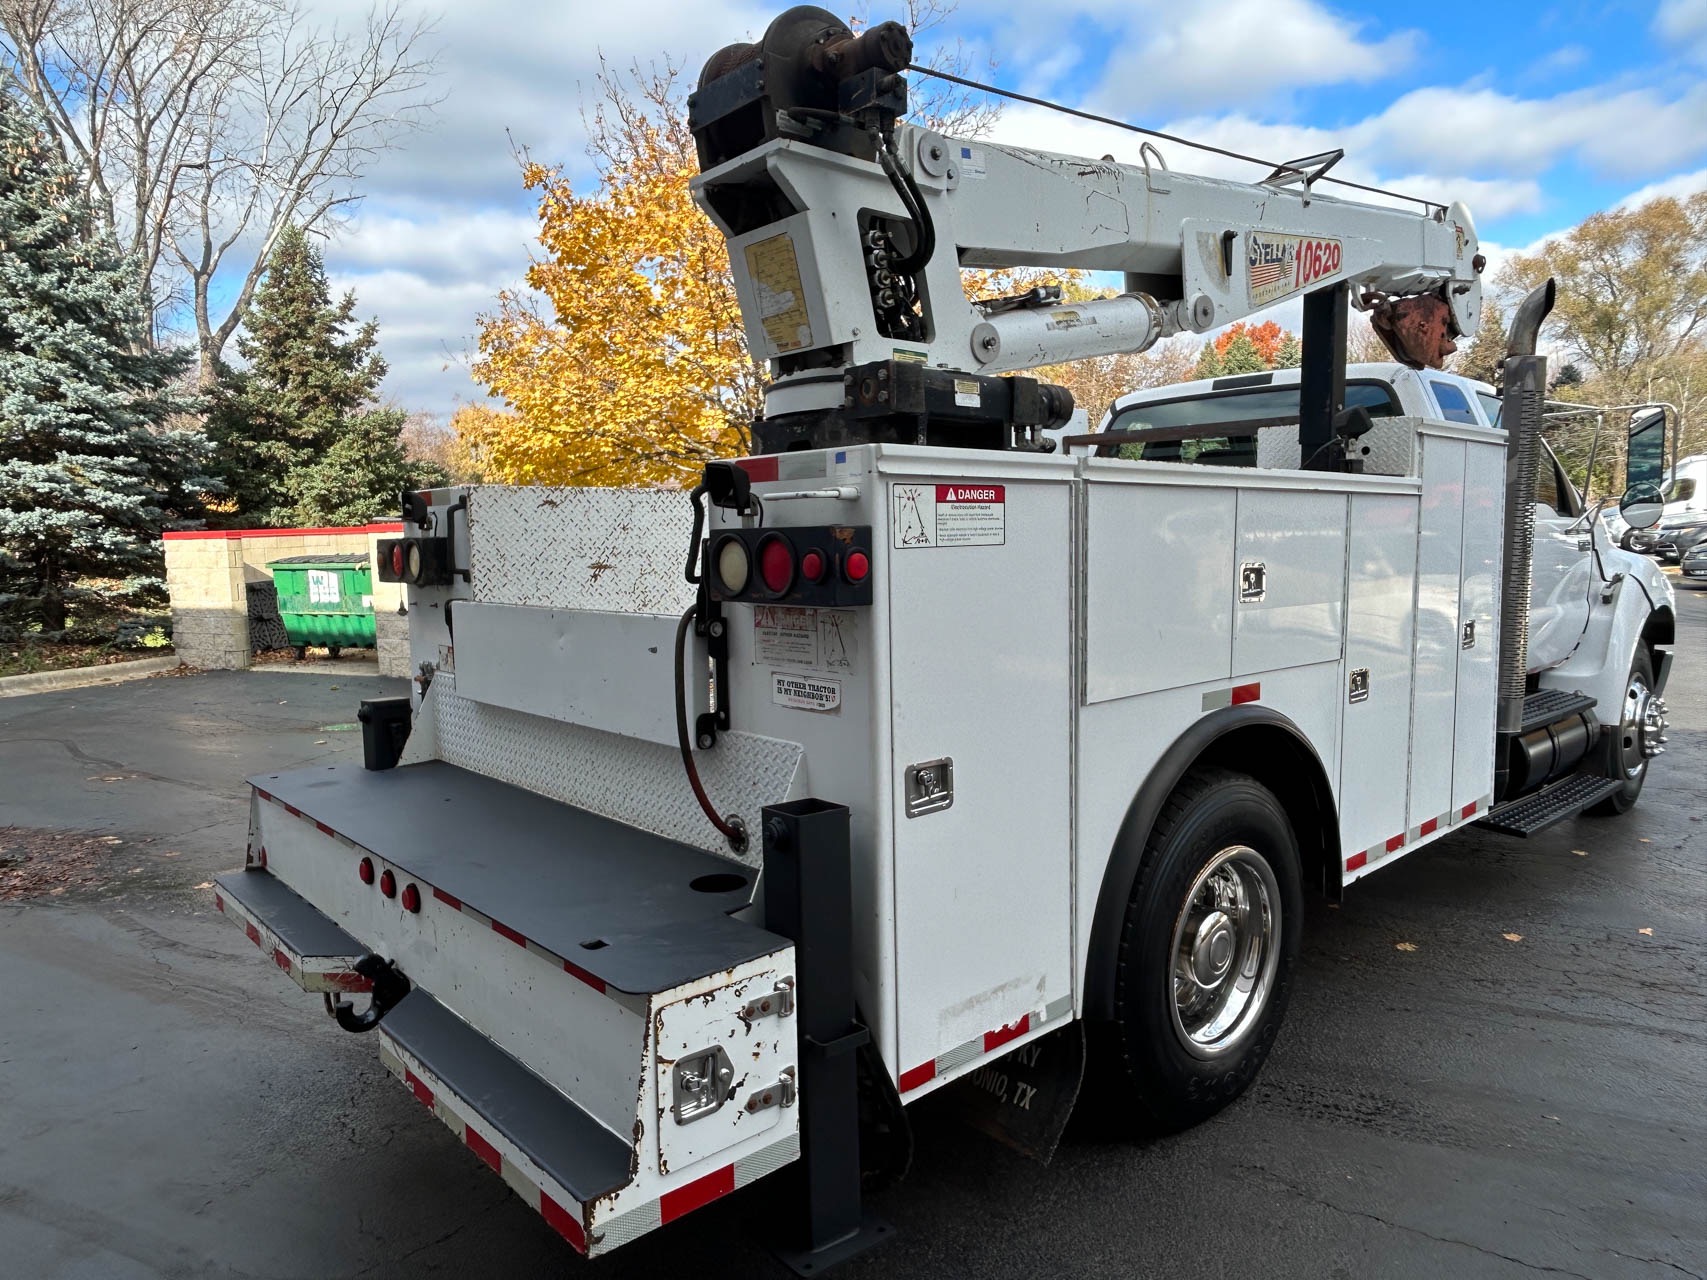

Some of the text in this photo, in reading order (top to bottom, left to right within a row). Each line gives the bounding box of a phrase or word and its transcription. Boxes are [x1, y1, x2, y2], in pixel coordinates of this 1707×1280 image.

[1295, 239, 1341, 289] 10620
[958, 489, 995, 501] DANGER
[777, 687, 783, 695] IS
[784, 688, 792, 696] MY
[787, 681, 807, 690] OTHER
[807, 683, 836, 695] TRACTOR
[972, 1069, 1038, 1111] ONIO, TX
